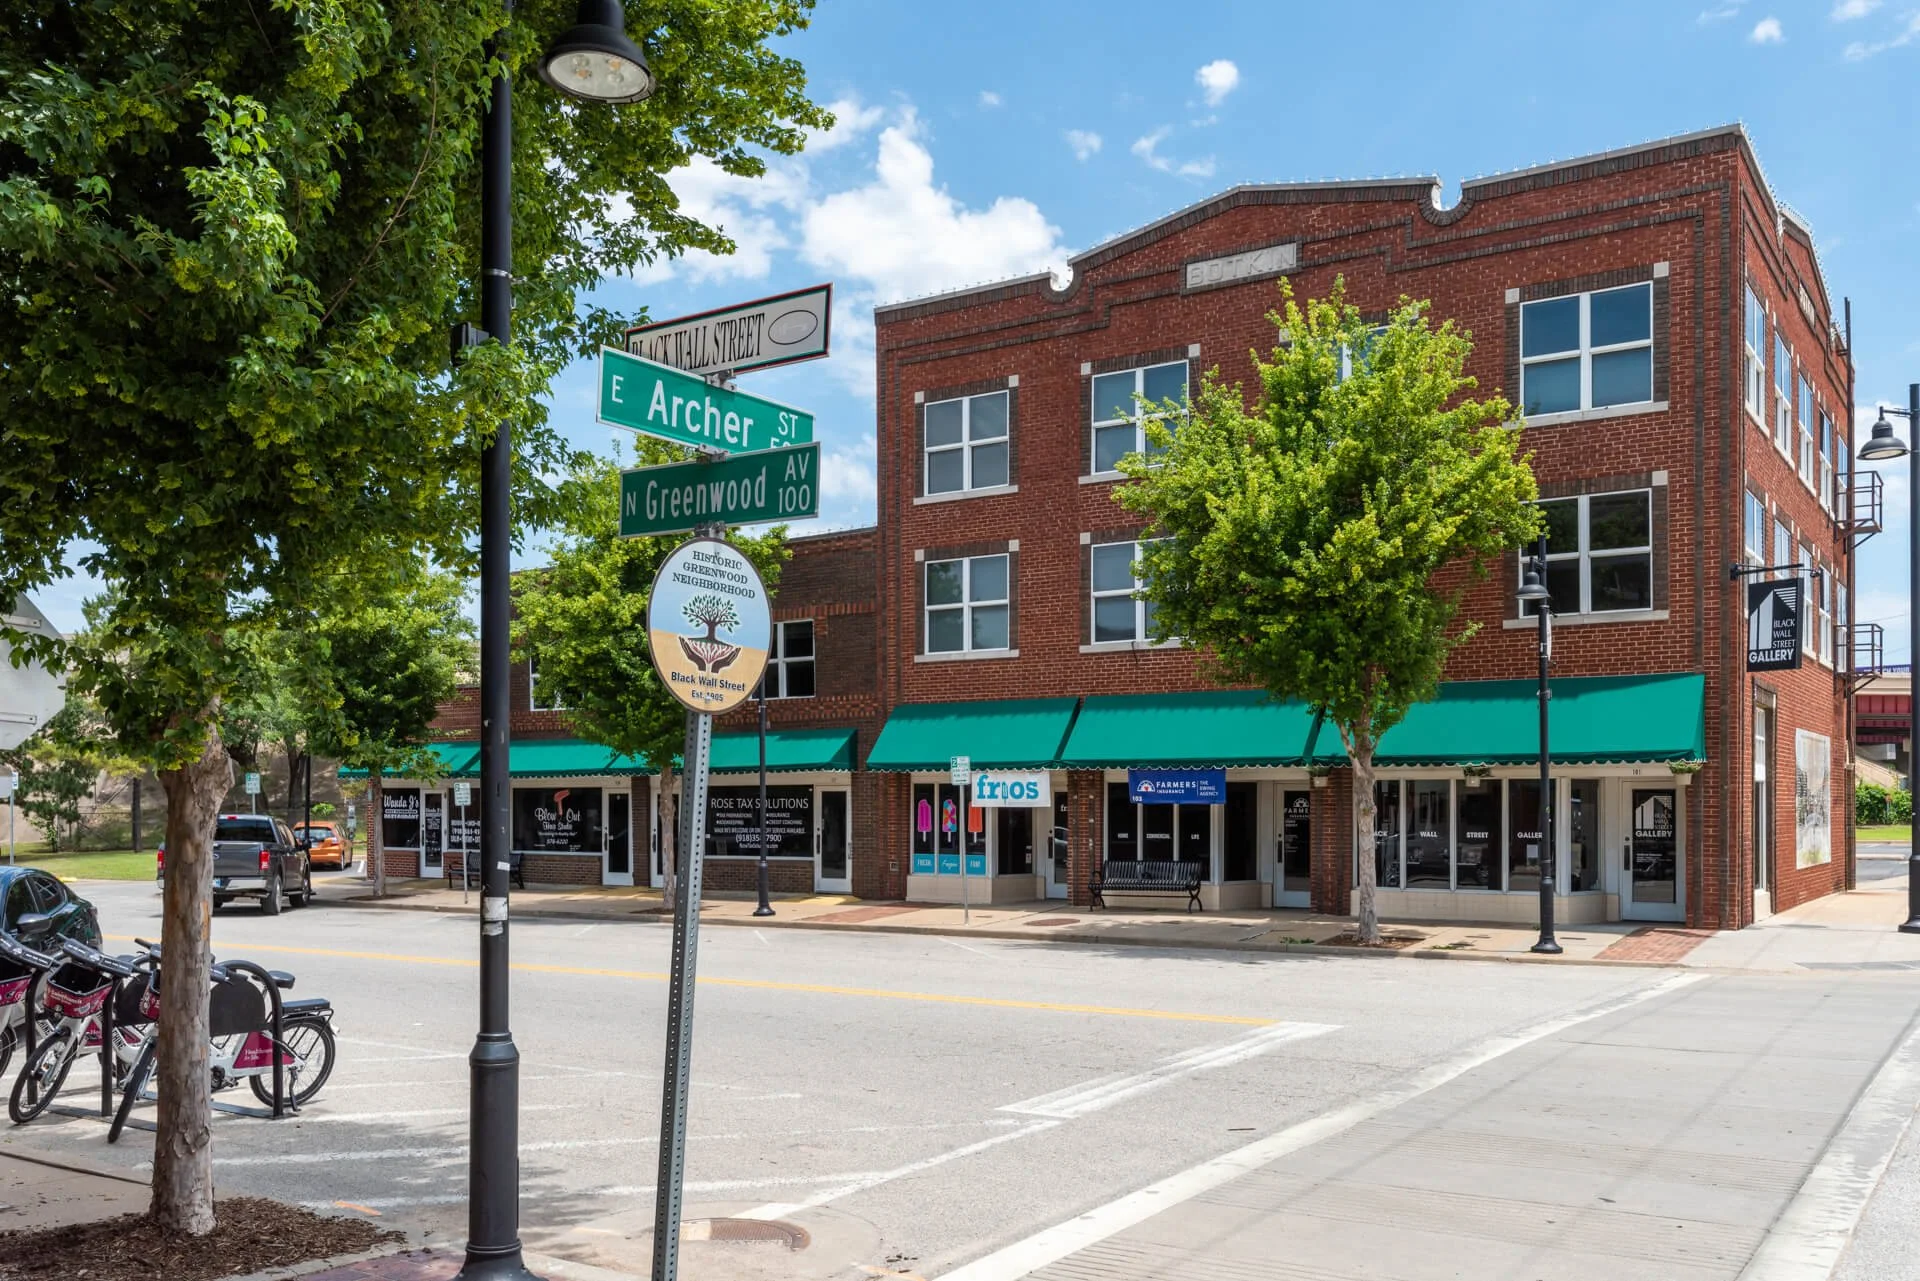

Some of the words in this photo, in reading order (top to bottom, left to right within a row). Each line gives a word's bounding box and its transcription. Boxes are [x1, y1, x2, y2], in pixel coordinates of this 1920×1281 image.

[674, 326, 709, 371] WALL
[712, 312, 765, 366] STREET
[611, 374, 624, 404] E
[647, 379, 754, 447] Archer
[778, 411, 799, 439] ST
[626, 491, 637, 517] N
[646, 465, 767, 521] Greenwood
[784, 452, 810, 482] AV
[778, 484, 811, 514] 100
[692, 550, 743, 570] HISTORIC
[682, 561, 748, 585] GREENWOOD
[672, 572, 756, 599] NEIGHBORHOOD
[1773, 618, 1796, 629] BLACK
[1773, 629, 1792, 638] WALL
[1772, 639, 1796, 649] STREET
[1749, 648, 1794, 663] GALLERY
[671, 671, 696, 684] Black
[698, 675, 717, 688] Wall
[719, 679, 745, 691] Street
[691, 690, 704, 699] Est.
[1156, 781, 1197, 789] FARMERS
[711, 798, 735, 809] ROSE
[736, 798, 753, 809] TAX
[755, 798, 809, 809] SLUTIONS
[535, 807, 557, 821] Blow
[566, 808, 580, 823] Out
[1466, 831, 1489, 839] STREET
[1517, 831, 1543, 839] GALLER
[1635, 829, 1673, 838] GALLERY
